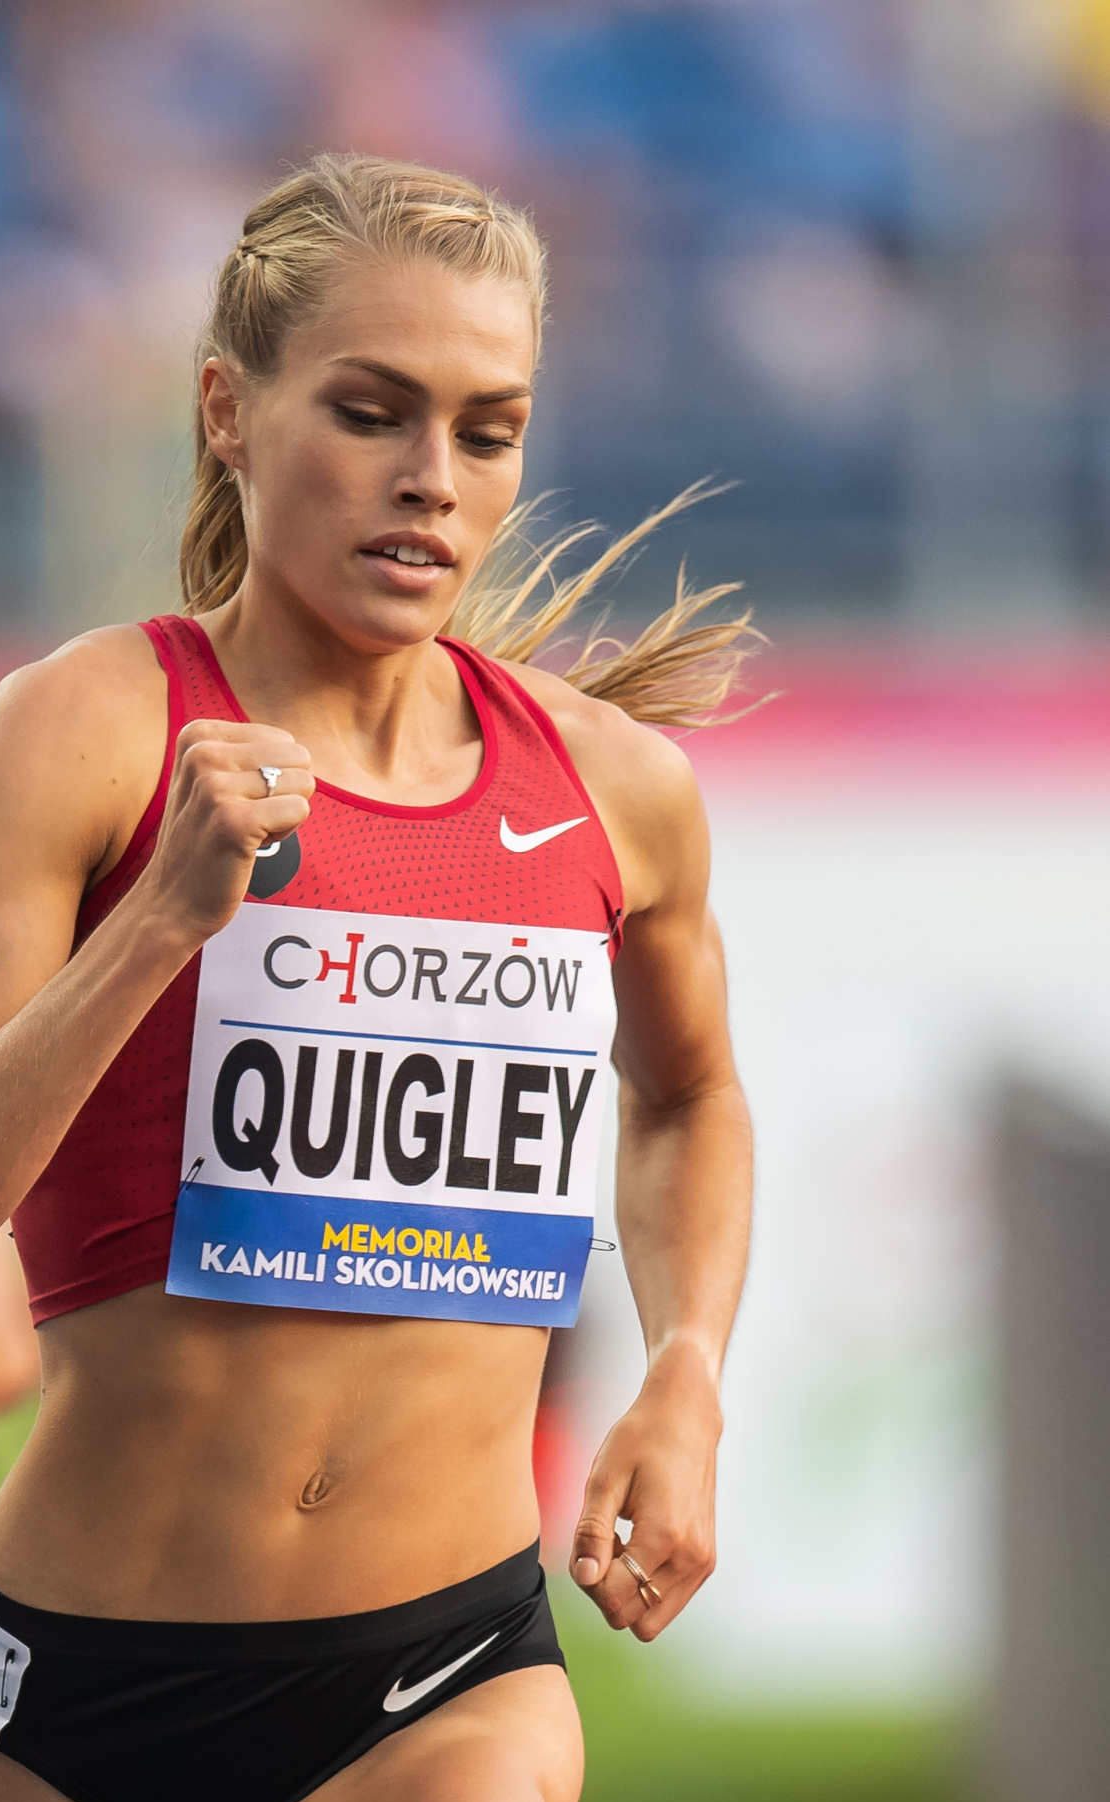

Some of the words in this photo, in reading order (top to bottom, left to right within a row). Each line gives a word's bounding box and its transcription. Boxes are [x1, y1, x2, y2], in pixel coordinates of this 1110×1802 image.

[212, 1038, 597, 1197] QUIGLEY
[321, 1221, 492, 1262] MEMORIAŁ
[199, 1242, 326, 1283] KAMILI
[334, 1255, 567, 1301] SKOLIMOWSKIEJ
